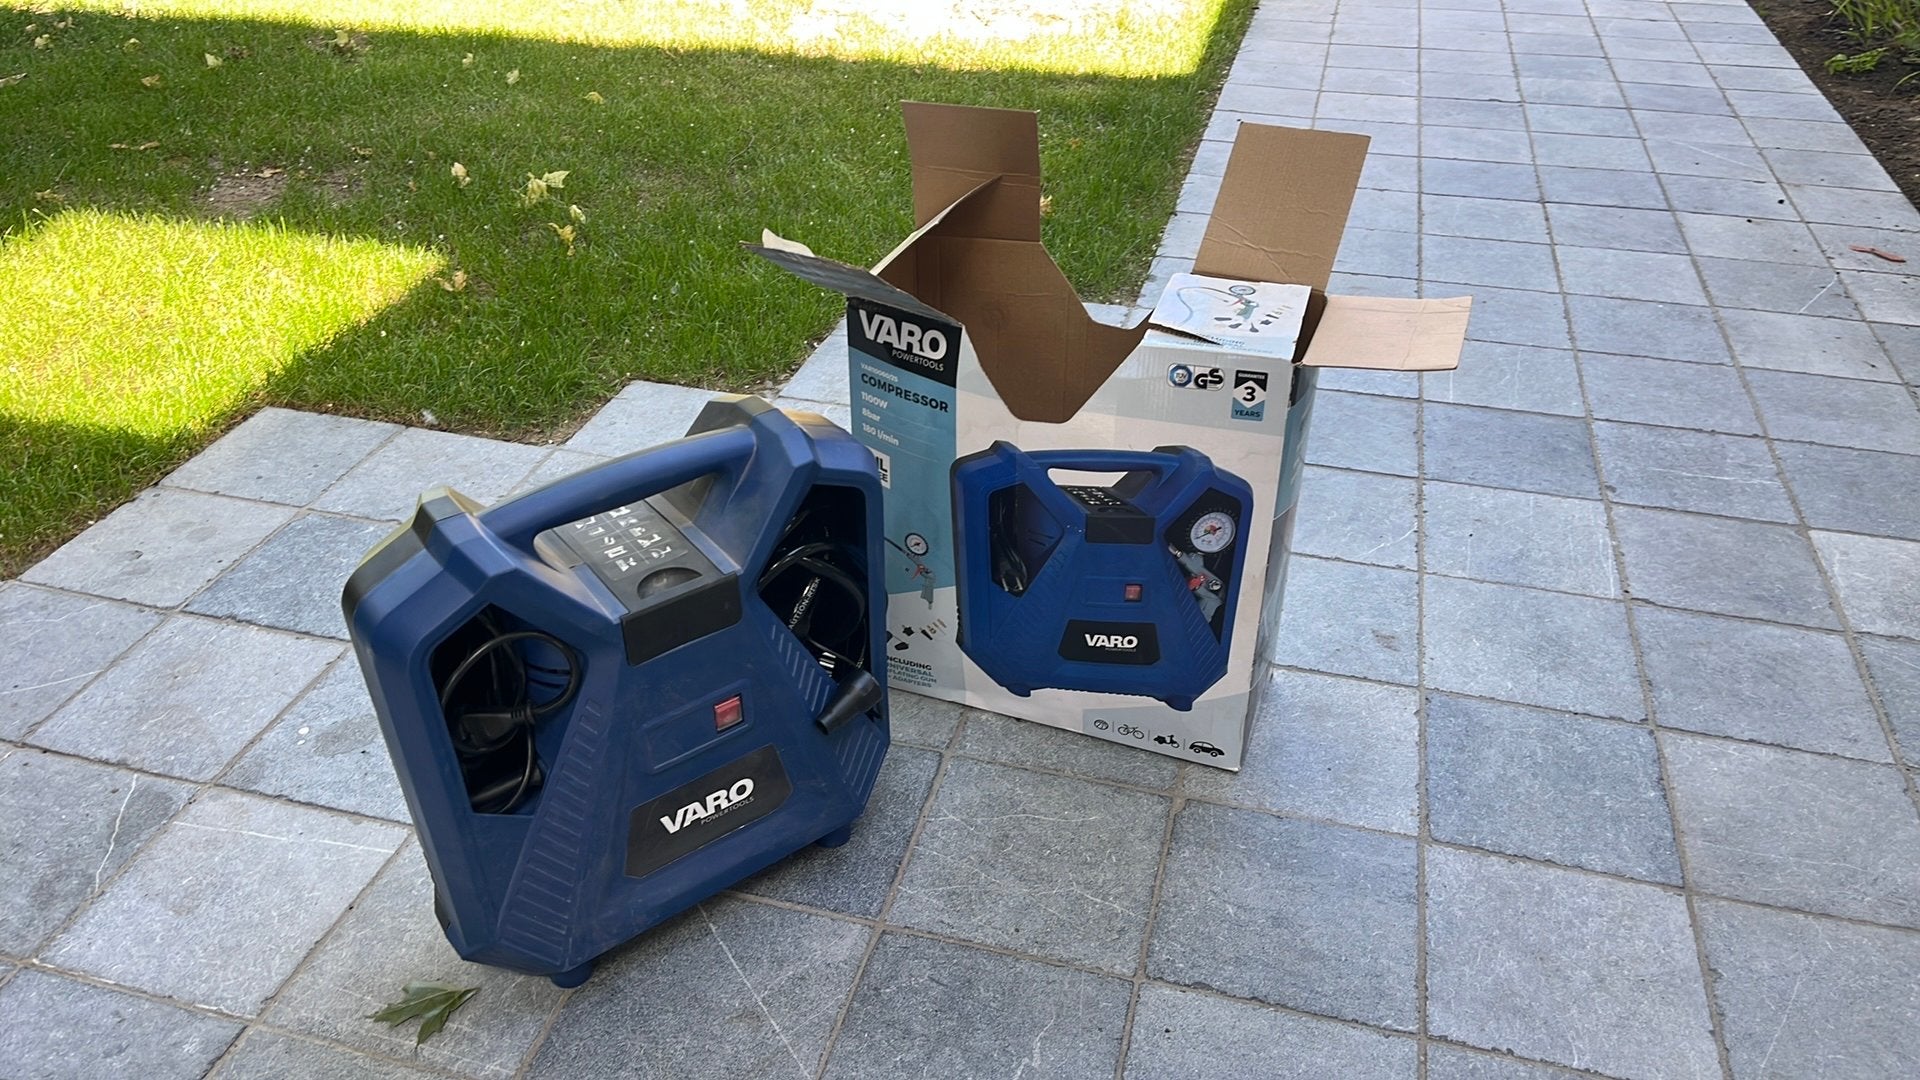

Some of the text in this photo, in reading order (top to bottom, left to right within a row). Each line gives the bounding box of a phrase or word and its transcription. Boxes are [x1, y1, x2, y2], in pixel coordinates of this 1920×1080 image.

[859, 309, 947, 360] VARO
[892, 349, 944, 371] POWERTOOLS
[1194, 368, 1224, 389] GS
[861, 373, 949, 413] COMPRESSOR
[1242, 386, 1256, 402] 3
[1234, 409, 1260, 418] YEARS
[1084, 633, 1138, 648] VARO
[888, 656, 932, 670] NCLUDING
[660, 778, 754, 834] VARO
[701, 797, 754, 825] POWERTOOLS
